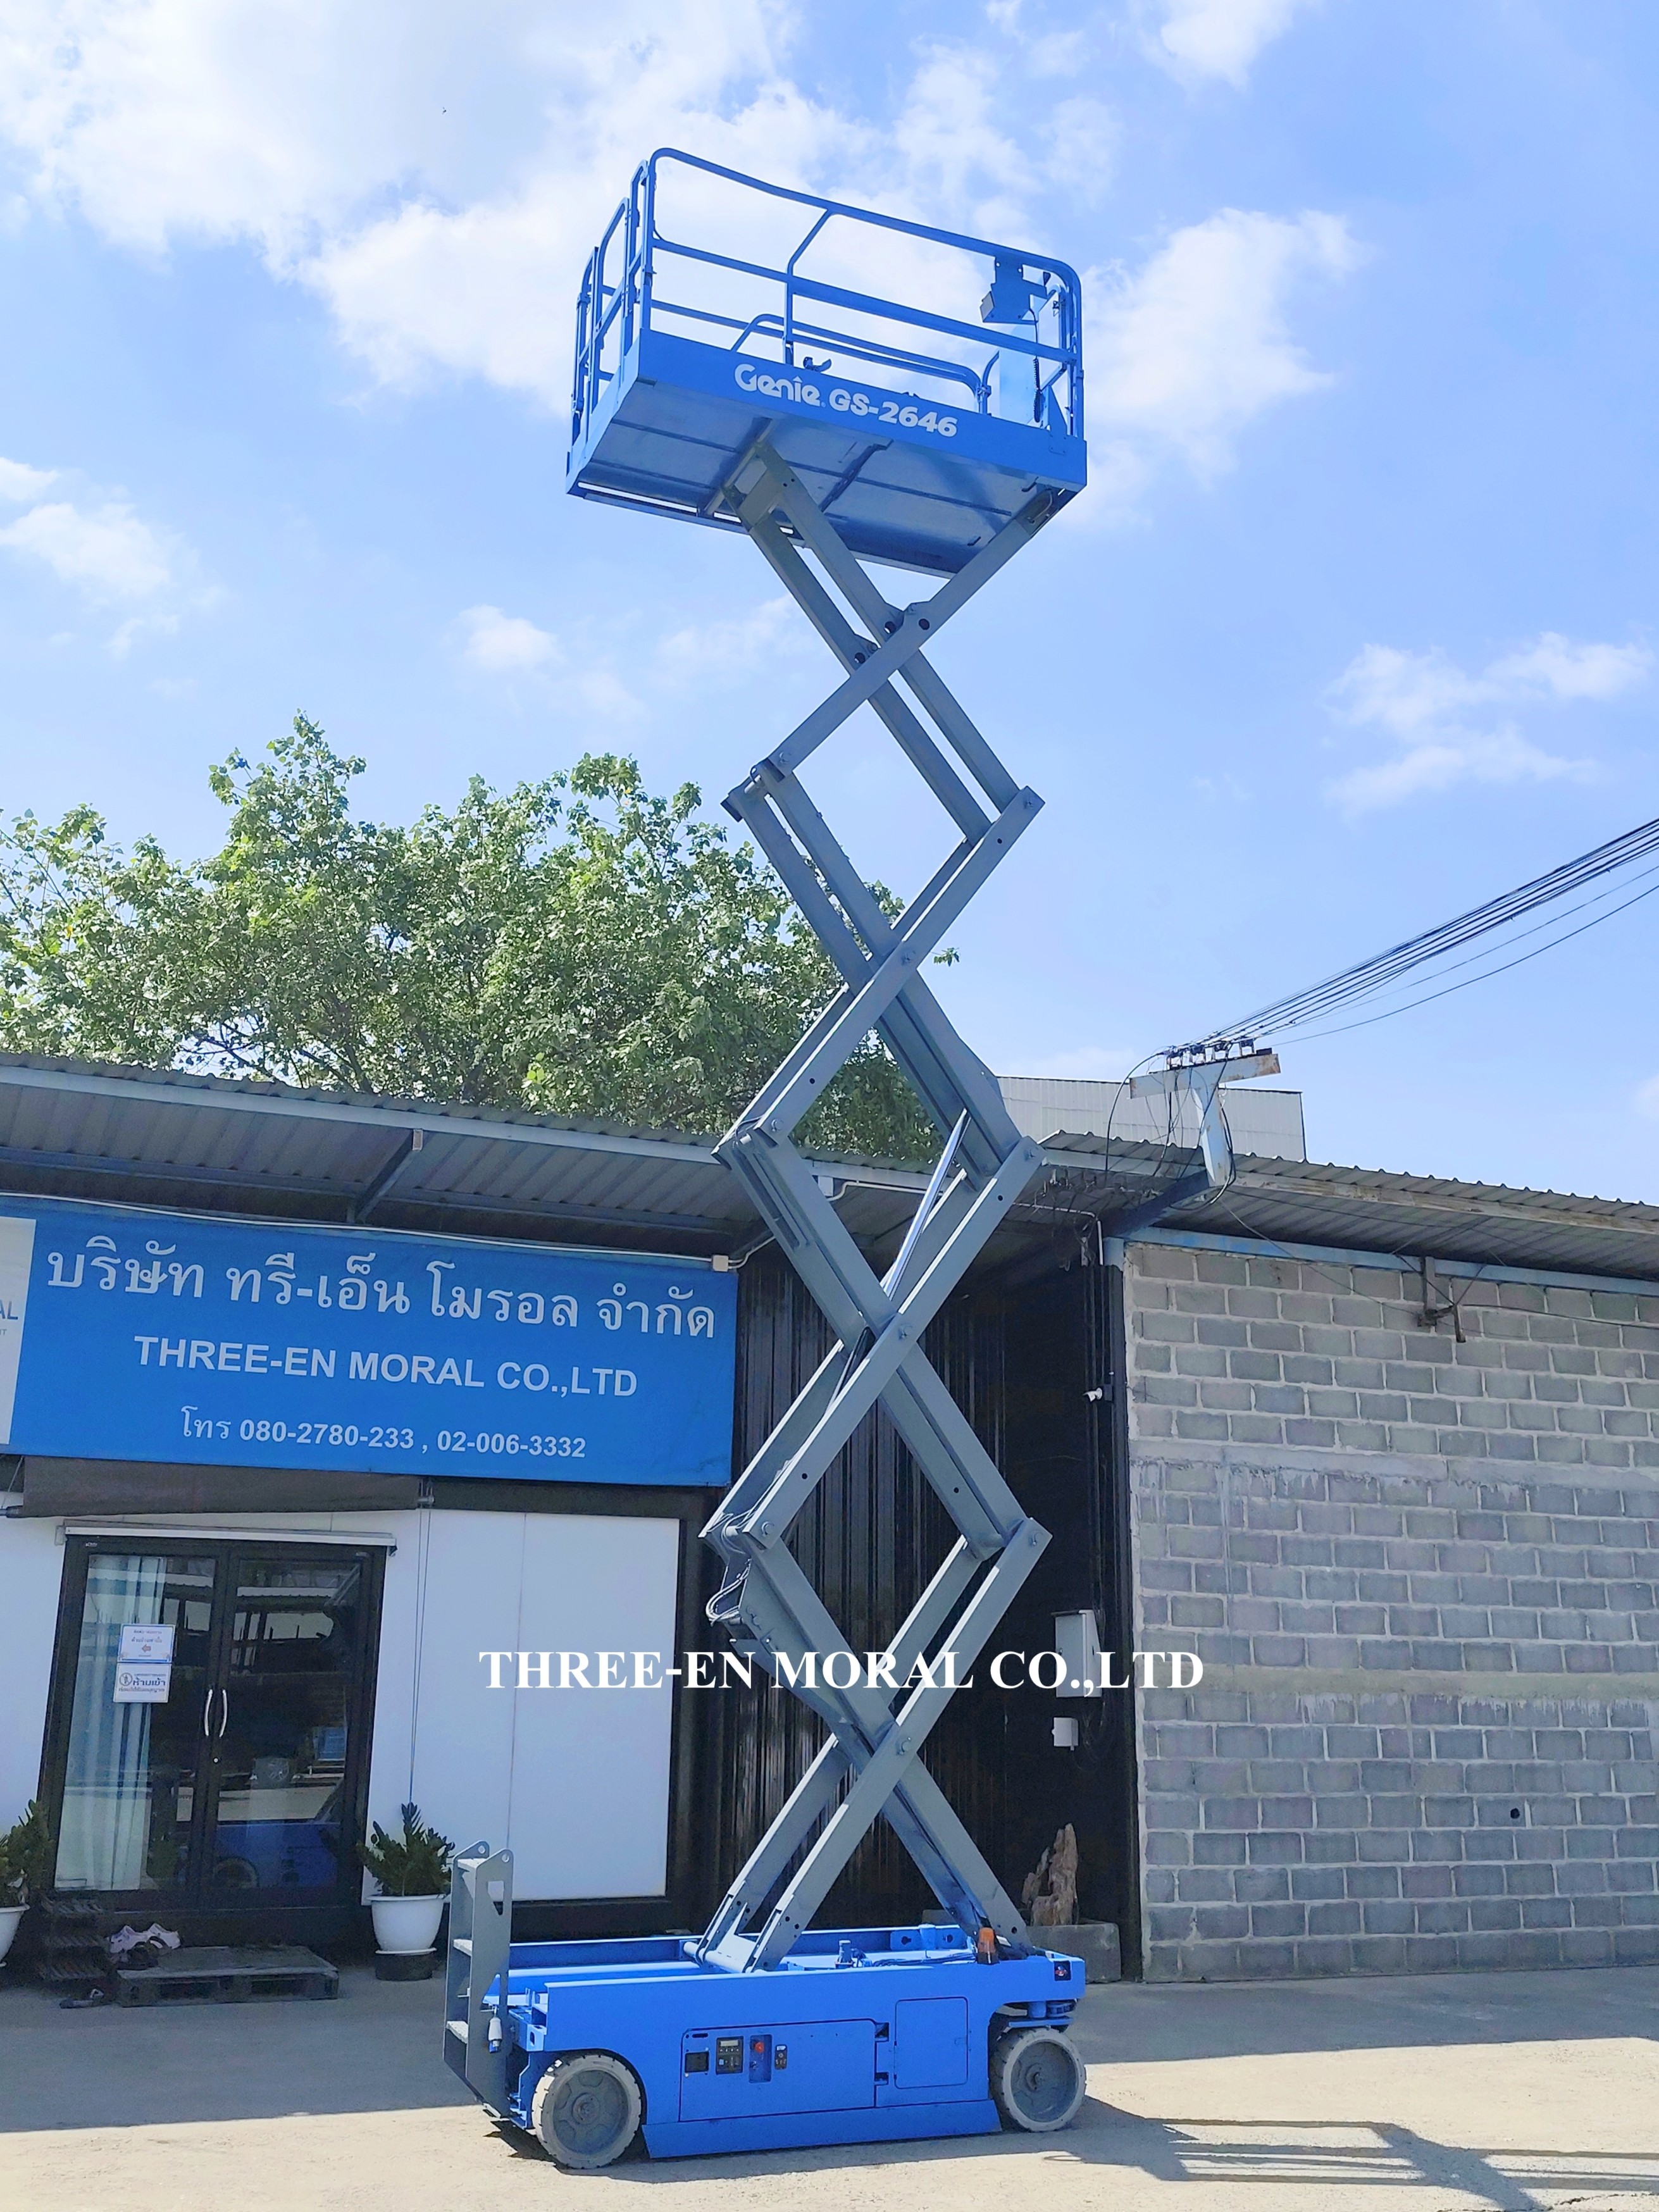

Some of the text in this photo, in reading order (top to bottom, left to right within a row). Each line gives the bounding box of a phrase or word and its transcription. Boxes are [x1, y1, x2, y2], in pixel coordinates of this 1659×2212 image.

[735, 364, 958, 437] Genie GS-2646
[47, 1235, 715, 1338] บริษัท ทรี-เอ็น โมรอล จำกัด
[134, 1335, 637, 1398] THREE-EN MORAL CO.,LTD
[180, 1405, 231, 1439] โทร
[240, 1419, 414, 1449] 080-2780-233
[437, 1430, 586, 1458] 02-006-3332
